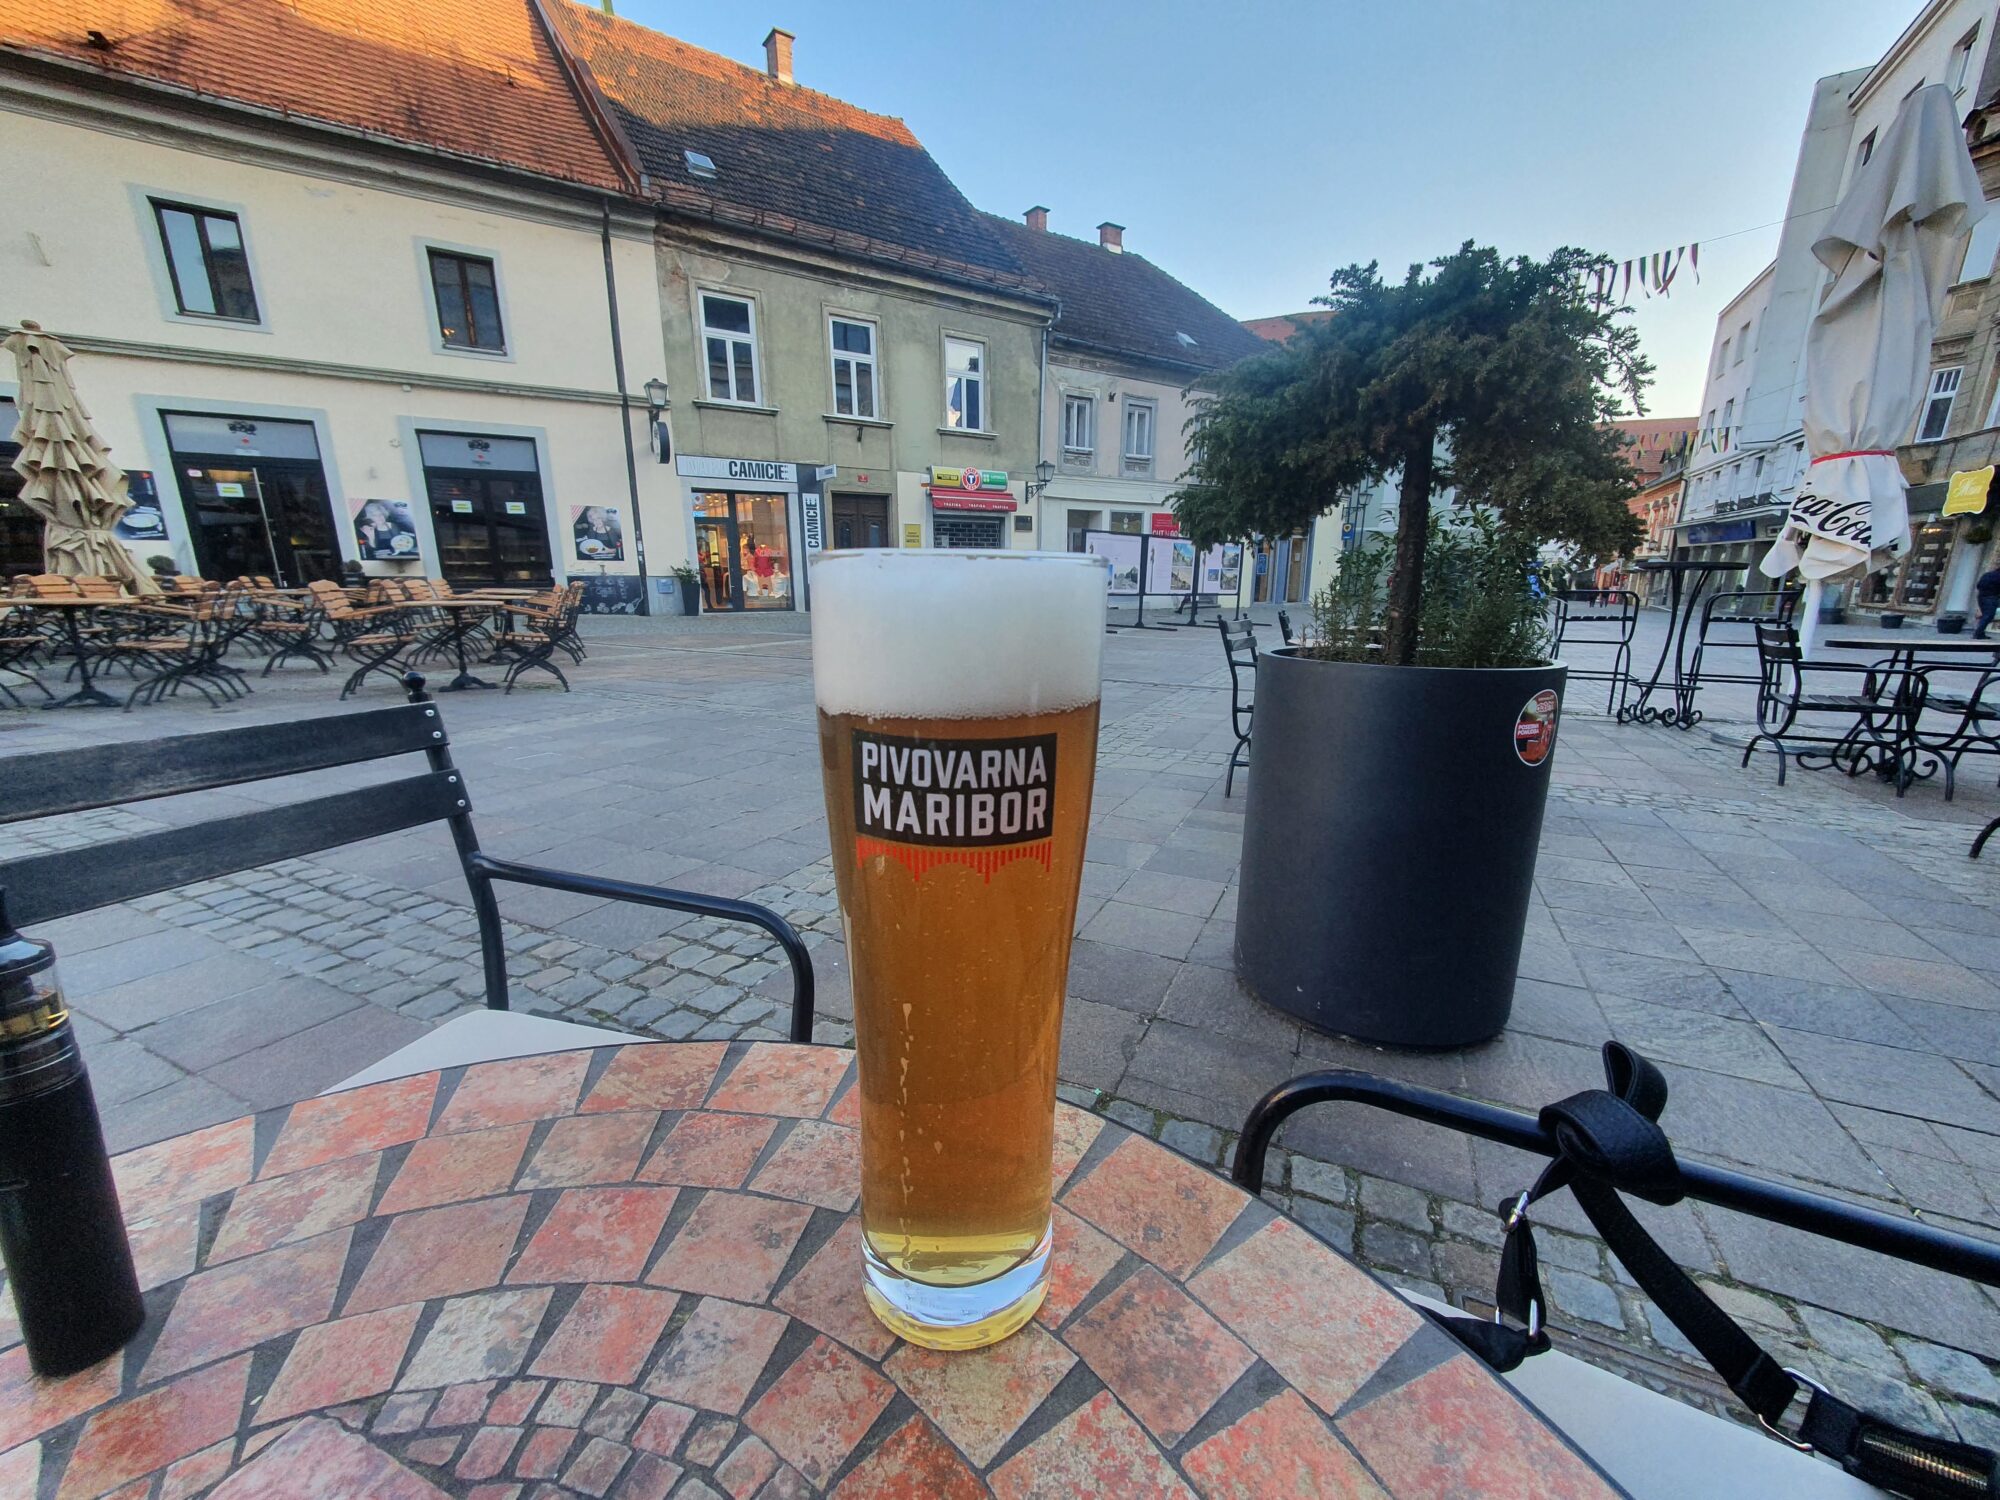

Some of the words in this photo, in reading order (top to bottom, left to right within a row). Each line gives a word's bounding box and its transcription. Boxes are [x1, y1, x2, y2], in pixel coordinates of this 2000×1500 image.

[728, 460, 785, 480] CAMICIE
[806, 497, 820, 549] CAMICIE
[861, 741, 1047, 789] PIVOVARNA
[863, 783, 1047, 837] MARIBOR
